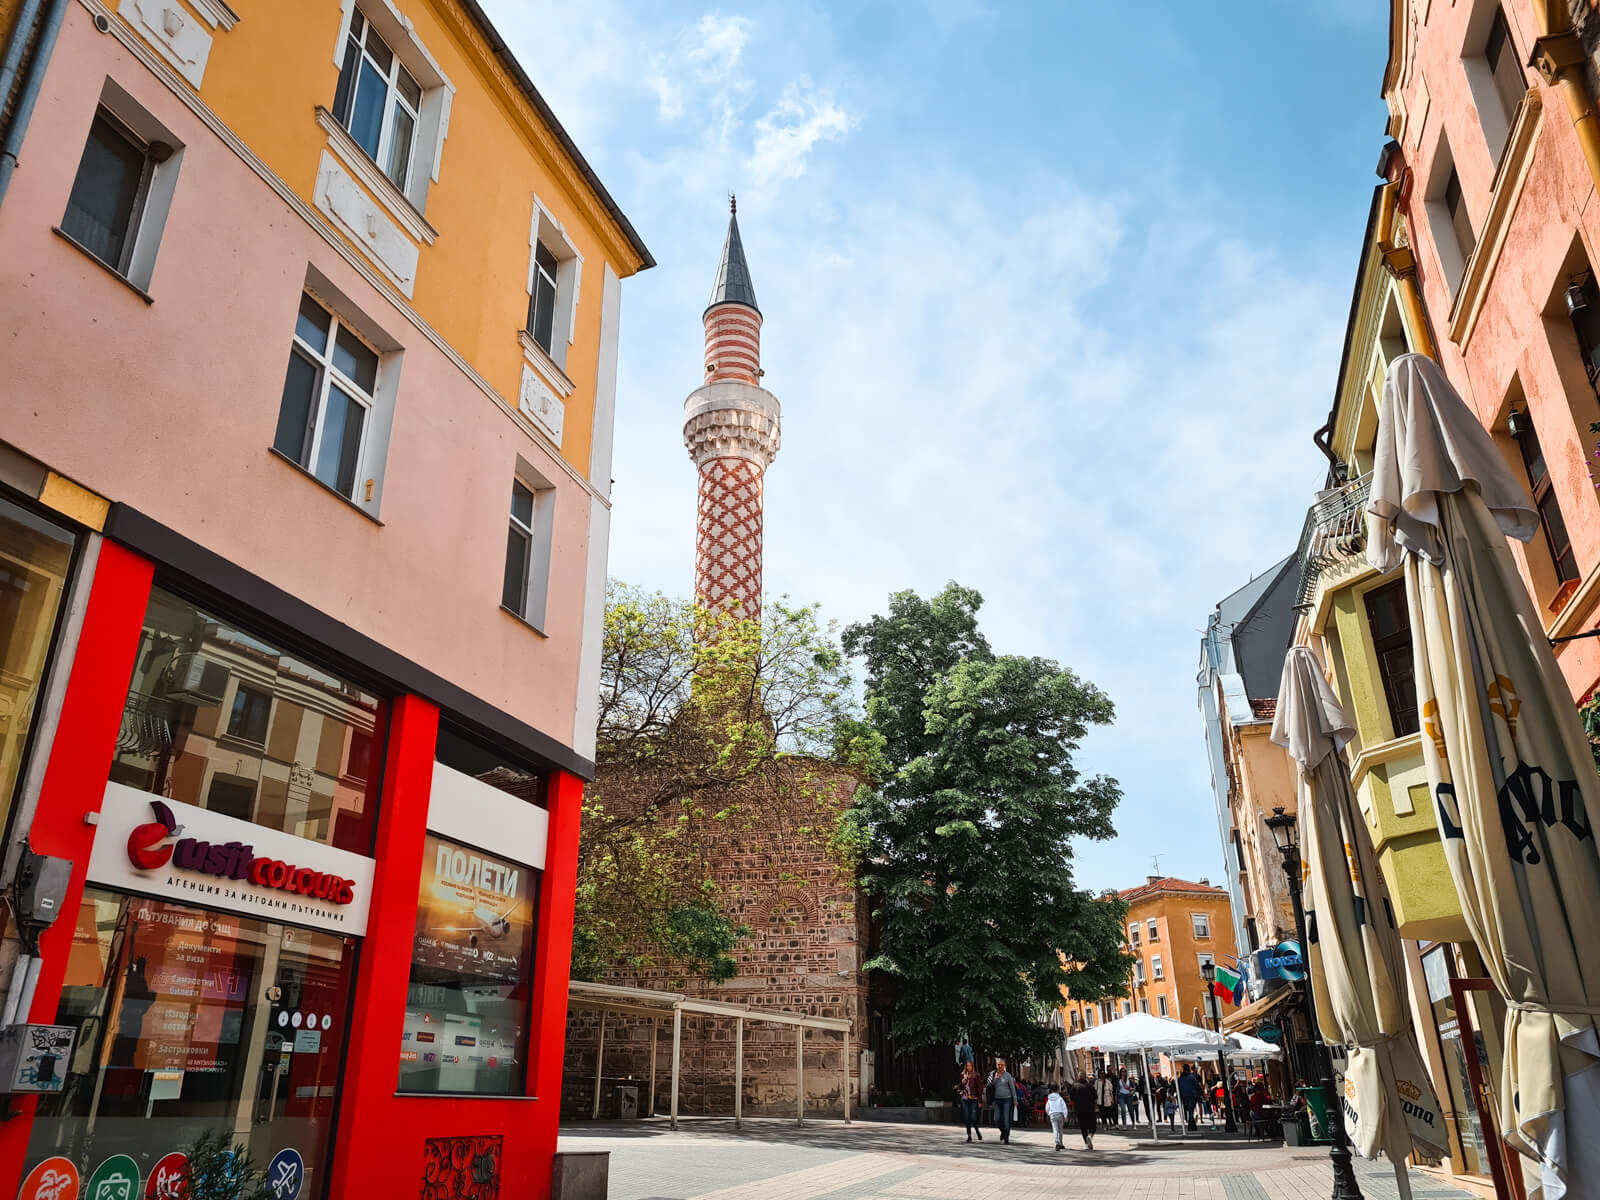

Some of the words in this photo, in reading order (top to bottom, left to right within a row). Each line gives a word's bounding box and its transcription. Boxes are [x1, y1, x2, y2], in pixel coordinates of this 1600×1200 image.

[435, 844, 518, 898] ПОЛЕТИ
[167, 877, 221, 895] АГЕНЦИЯ
[224, 889, 237, 899] ЗА
[241, 892, 287, 910] ИЗГОДНИ
[291, 904, 345, 922] ПЪТУВАНИЯ
[137, 908, 194, 929] ПЪТУВАНИЯ
[177, 941, 222, 954] Документи
[1344, 1099, 1359, 1126] ona
[1400, 1097, 1435, 1126] ona
